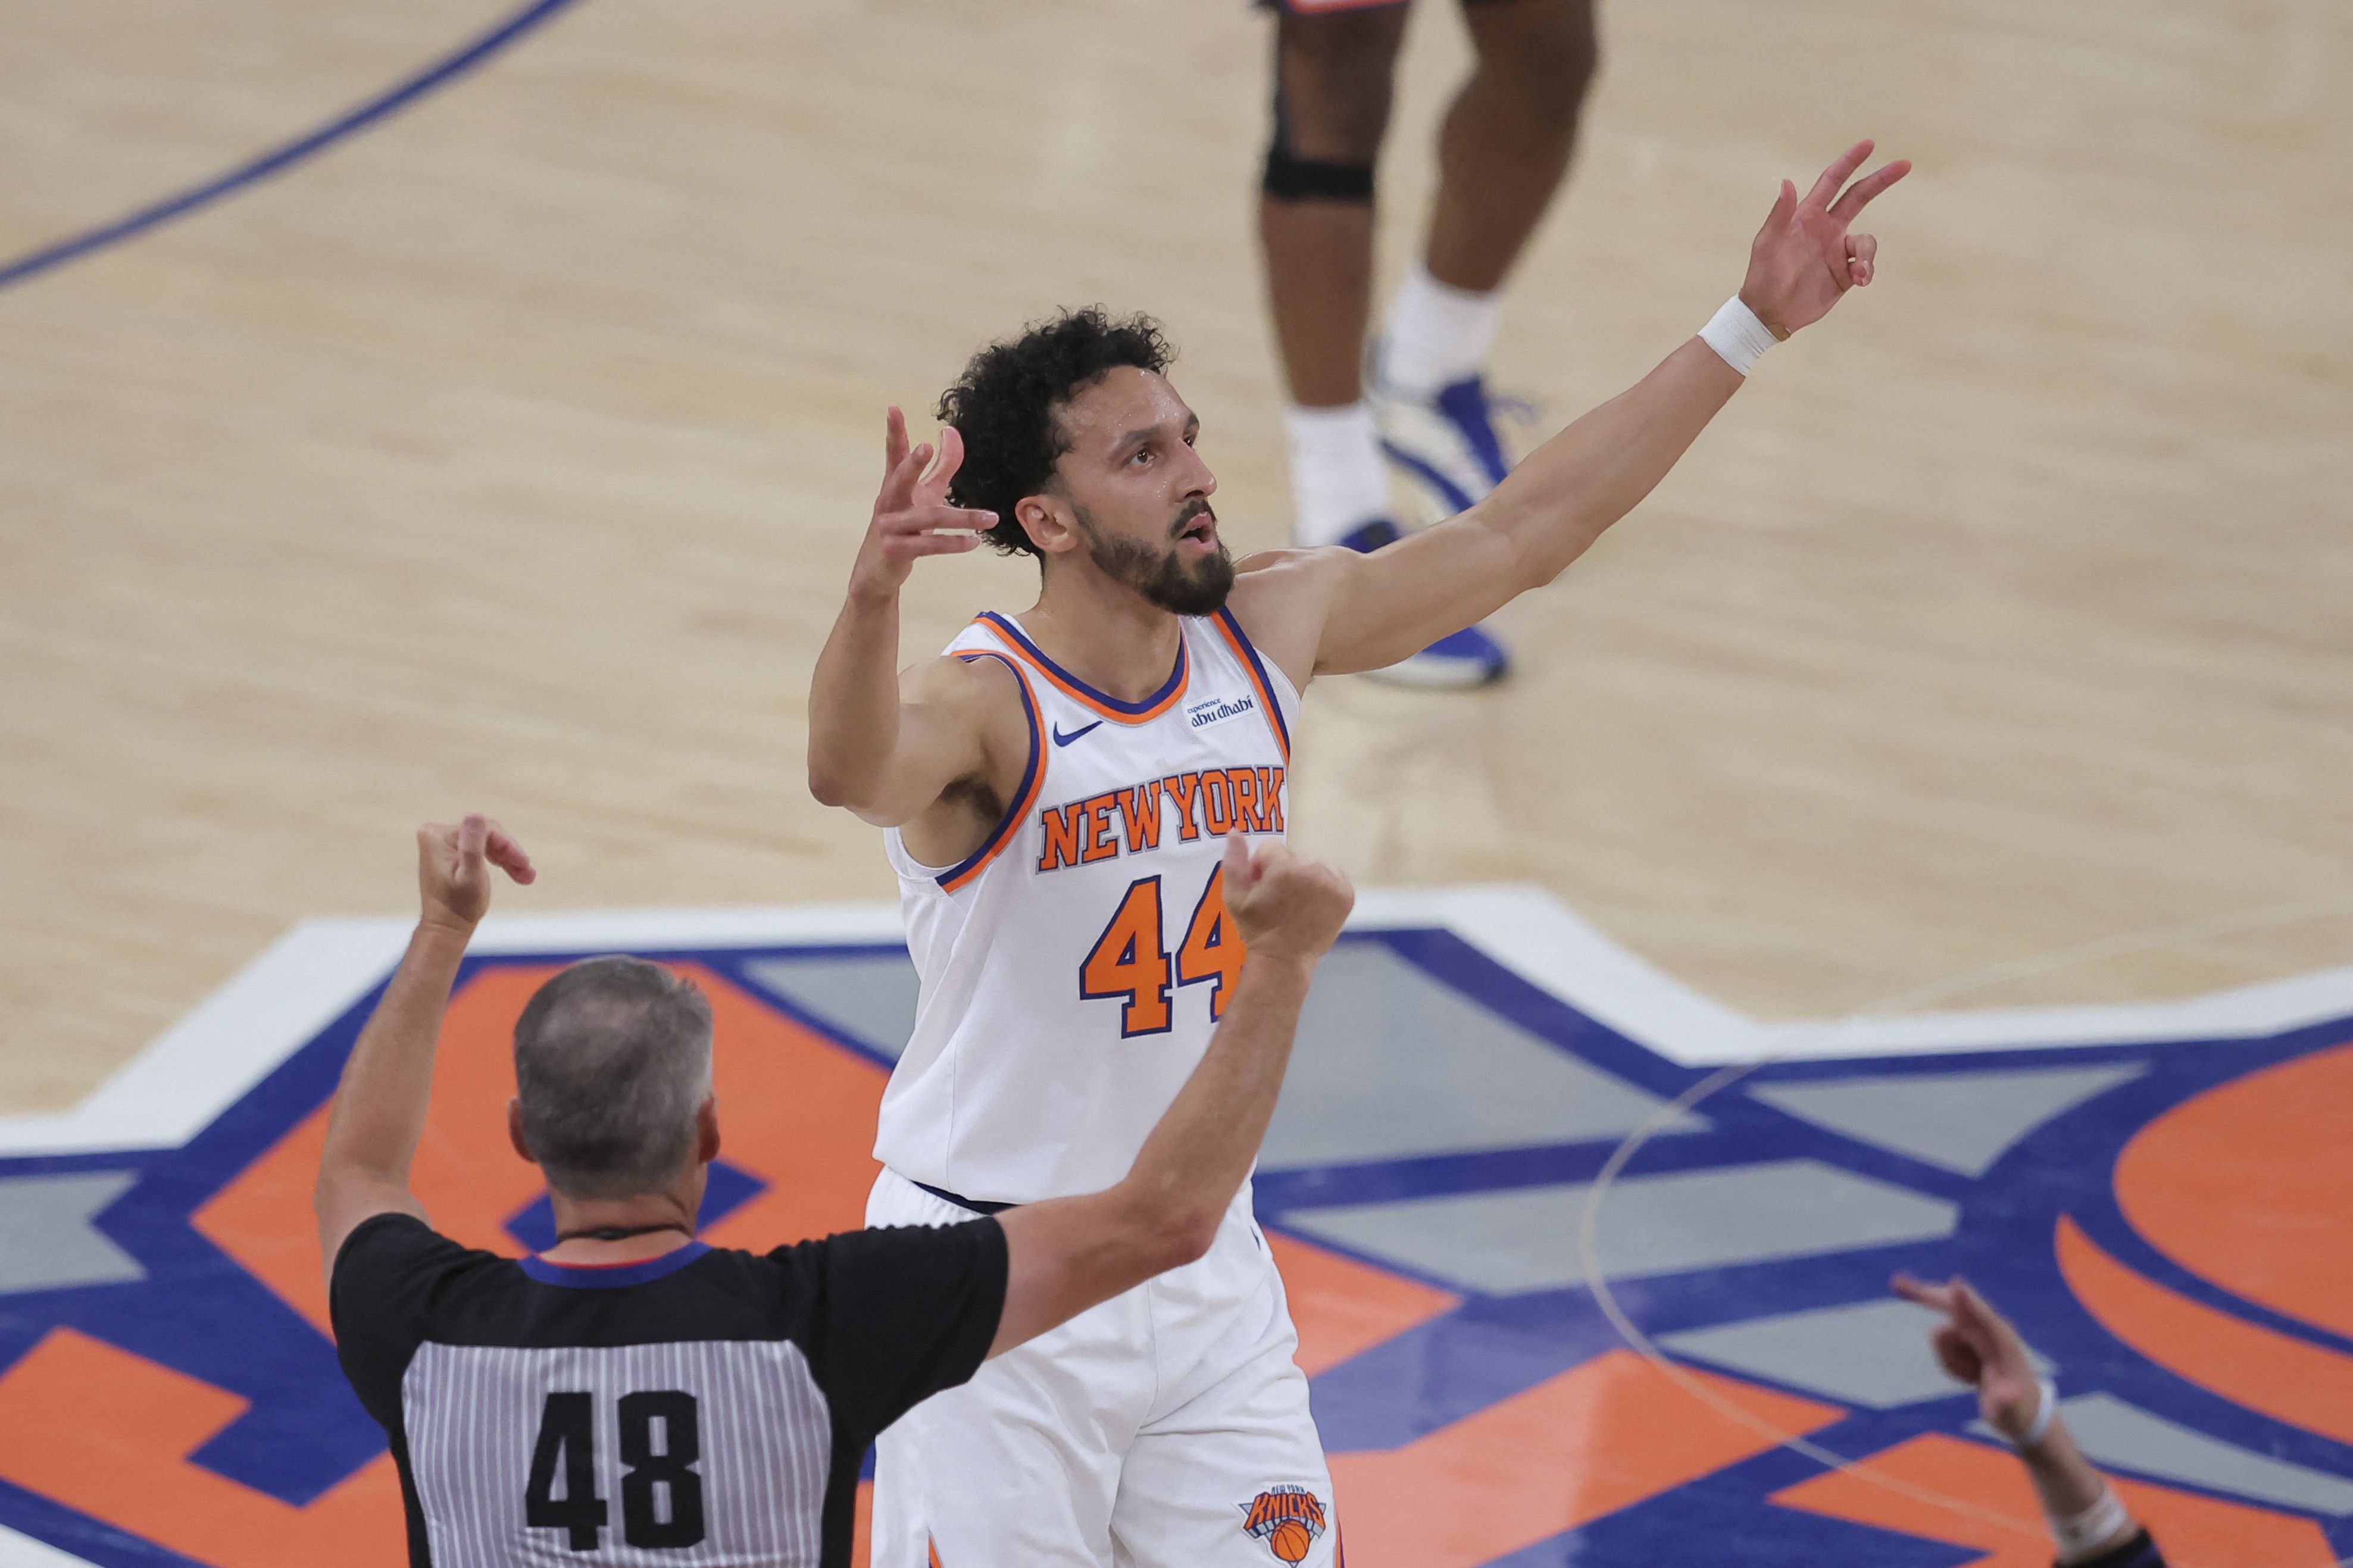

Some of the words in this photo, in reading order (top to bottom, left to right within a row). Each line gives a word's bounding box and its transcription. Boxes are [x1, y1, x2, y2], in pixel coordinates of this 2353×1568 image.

[1187, 698, 1221, 714] experience
[1191, 711, 1217, 727] abu
[1217, 694, 1254, 718] dhabi
[1036, 781, 1161, 874] NEW
[1162, 764, 1286, 845] YORK
[1079, 860, 1247, 1039] 44
[526, 1389, 705, 1551] 48
[1243, 1491, 1326, 1531] KNICKS
